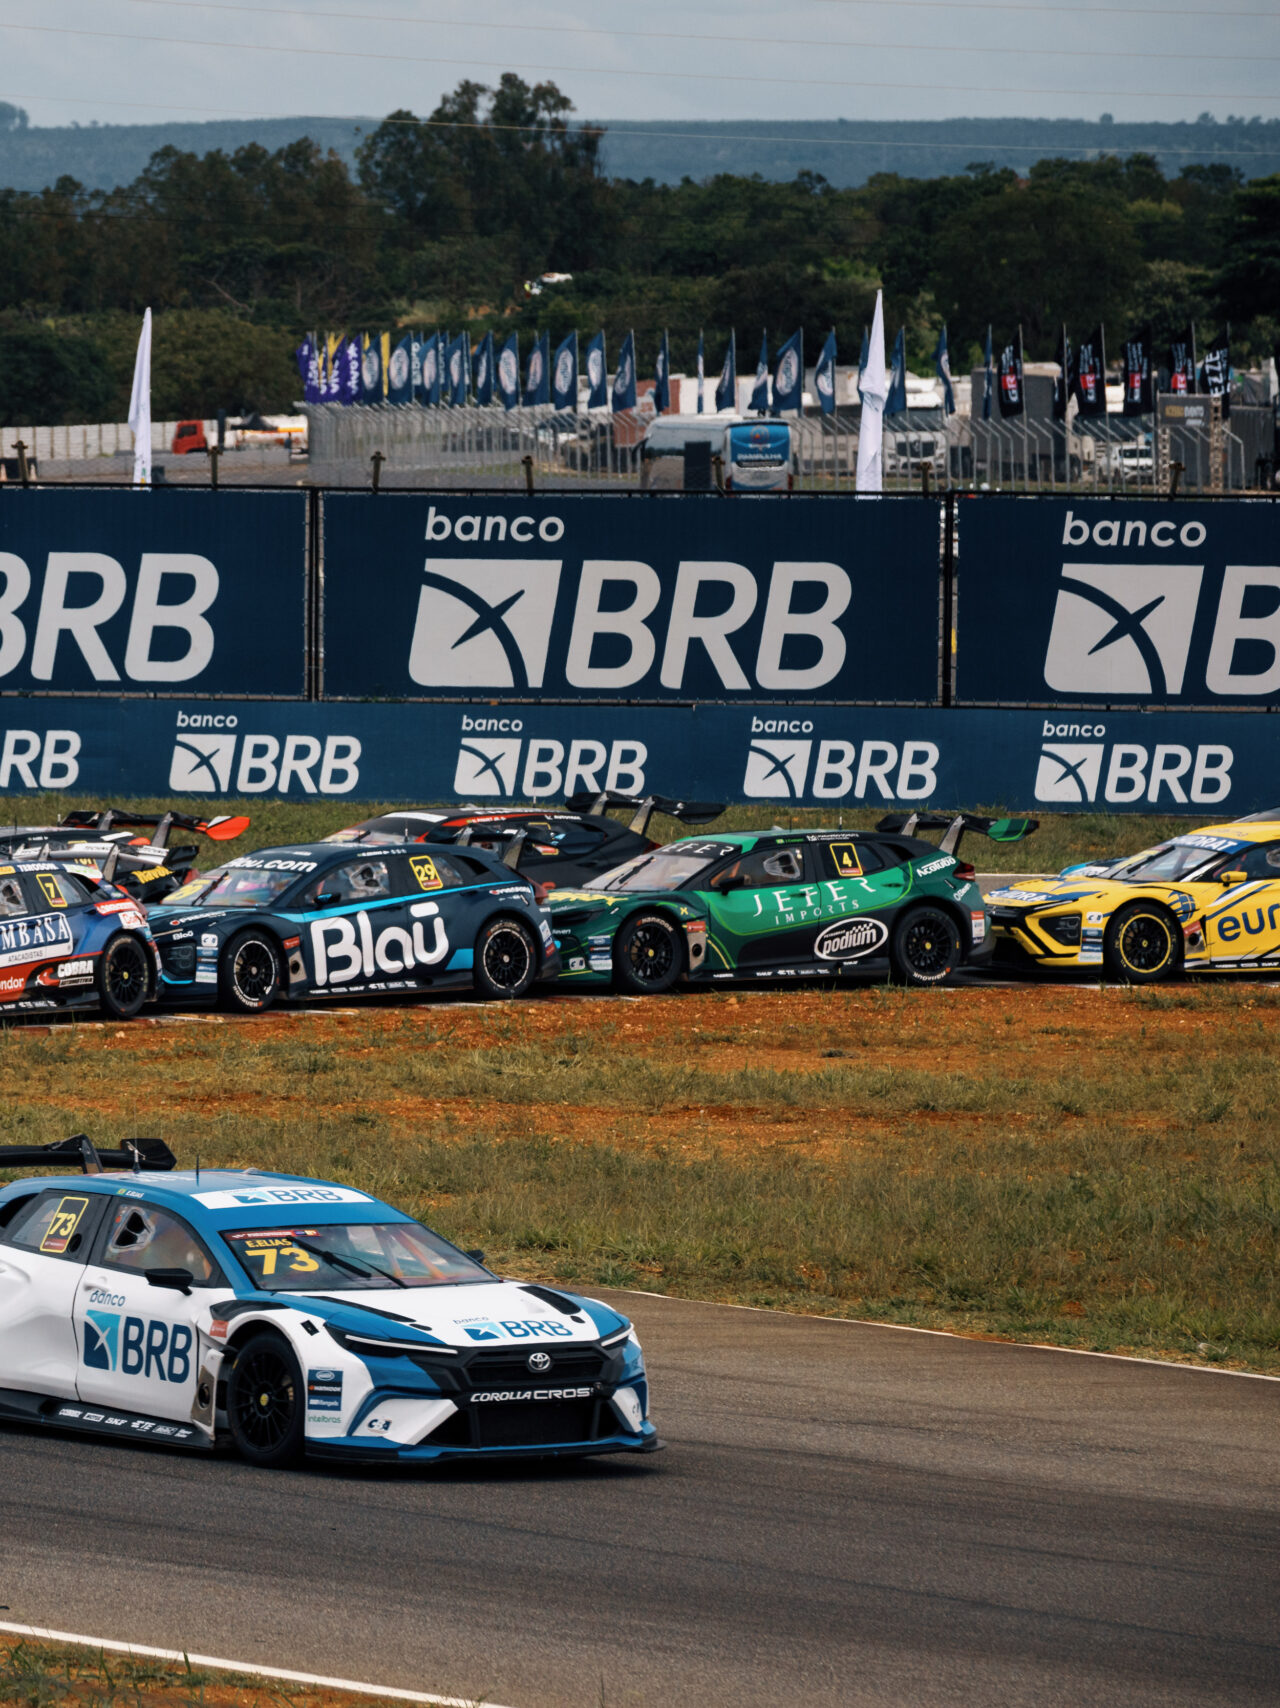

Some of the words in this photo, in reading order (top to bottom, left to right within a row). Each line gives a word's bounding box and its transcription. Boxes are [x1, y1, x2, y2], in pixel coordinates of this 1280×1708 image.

[426, 507, 564, 541] banco
[1063, 512, 1206, 546] banco
[566, 559, 851, 689] BRB
[177, 711, 237, 728] banco
[462, 715, 522, 731] banco
[752, 717, 813, 733] banco
[1043, 720, 1105, 737] banco
[237, 734, 361, 794] BRB
[522, 738, 647, 798] BRB
[813, 740, 939, 800] BRB
[1105, 744, 1233, 803] BRB
[843, 852, 853, 867] 4
[415, 864, 437, 881] 29
[45, 883, 56, 899] 7
[753, 877, 876, 917] JEFER
[775, 899, 860, 925] IMPORTS
[823, 928, 877, 956] podium
[57, 959, 94, 977] COBRA
[268, 1189, 343, 1202] BRB
[48, 1212, 77, 1237] 73
[245, 1238, 293, 1248] E.ELIAS
[245, 1247, 320, 1275] 73
[89, 1289, 126, 1307] banco
[498, 1320, 573, 1338] BRB
[122, 1316, 193, 1384] BRB
[470, 1390, 533, 1402] COROLLA
[533, 1387, 594, 1400] CROS
